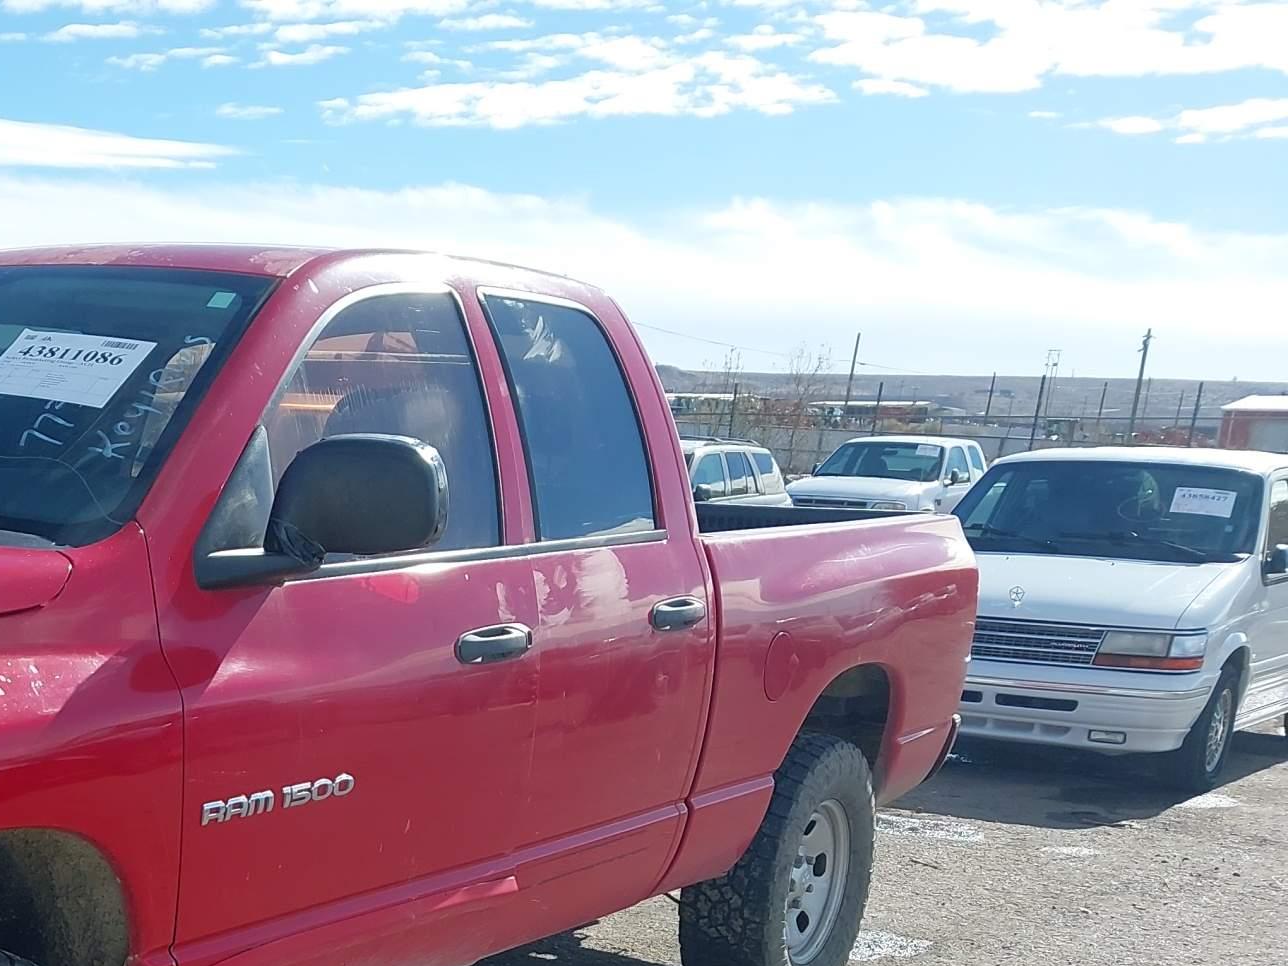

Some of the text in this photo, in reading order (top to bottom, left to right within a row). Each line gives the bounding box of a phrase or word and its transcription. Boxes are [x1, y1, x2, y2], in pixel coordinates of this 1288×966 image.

[17, 343, 129, 367] 43811086
[200, 772, 356, 827] RAM 1500
